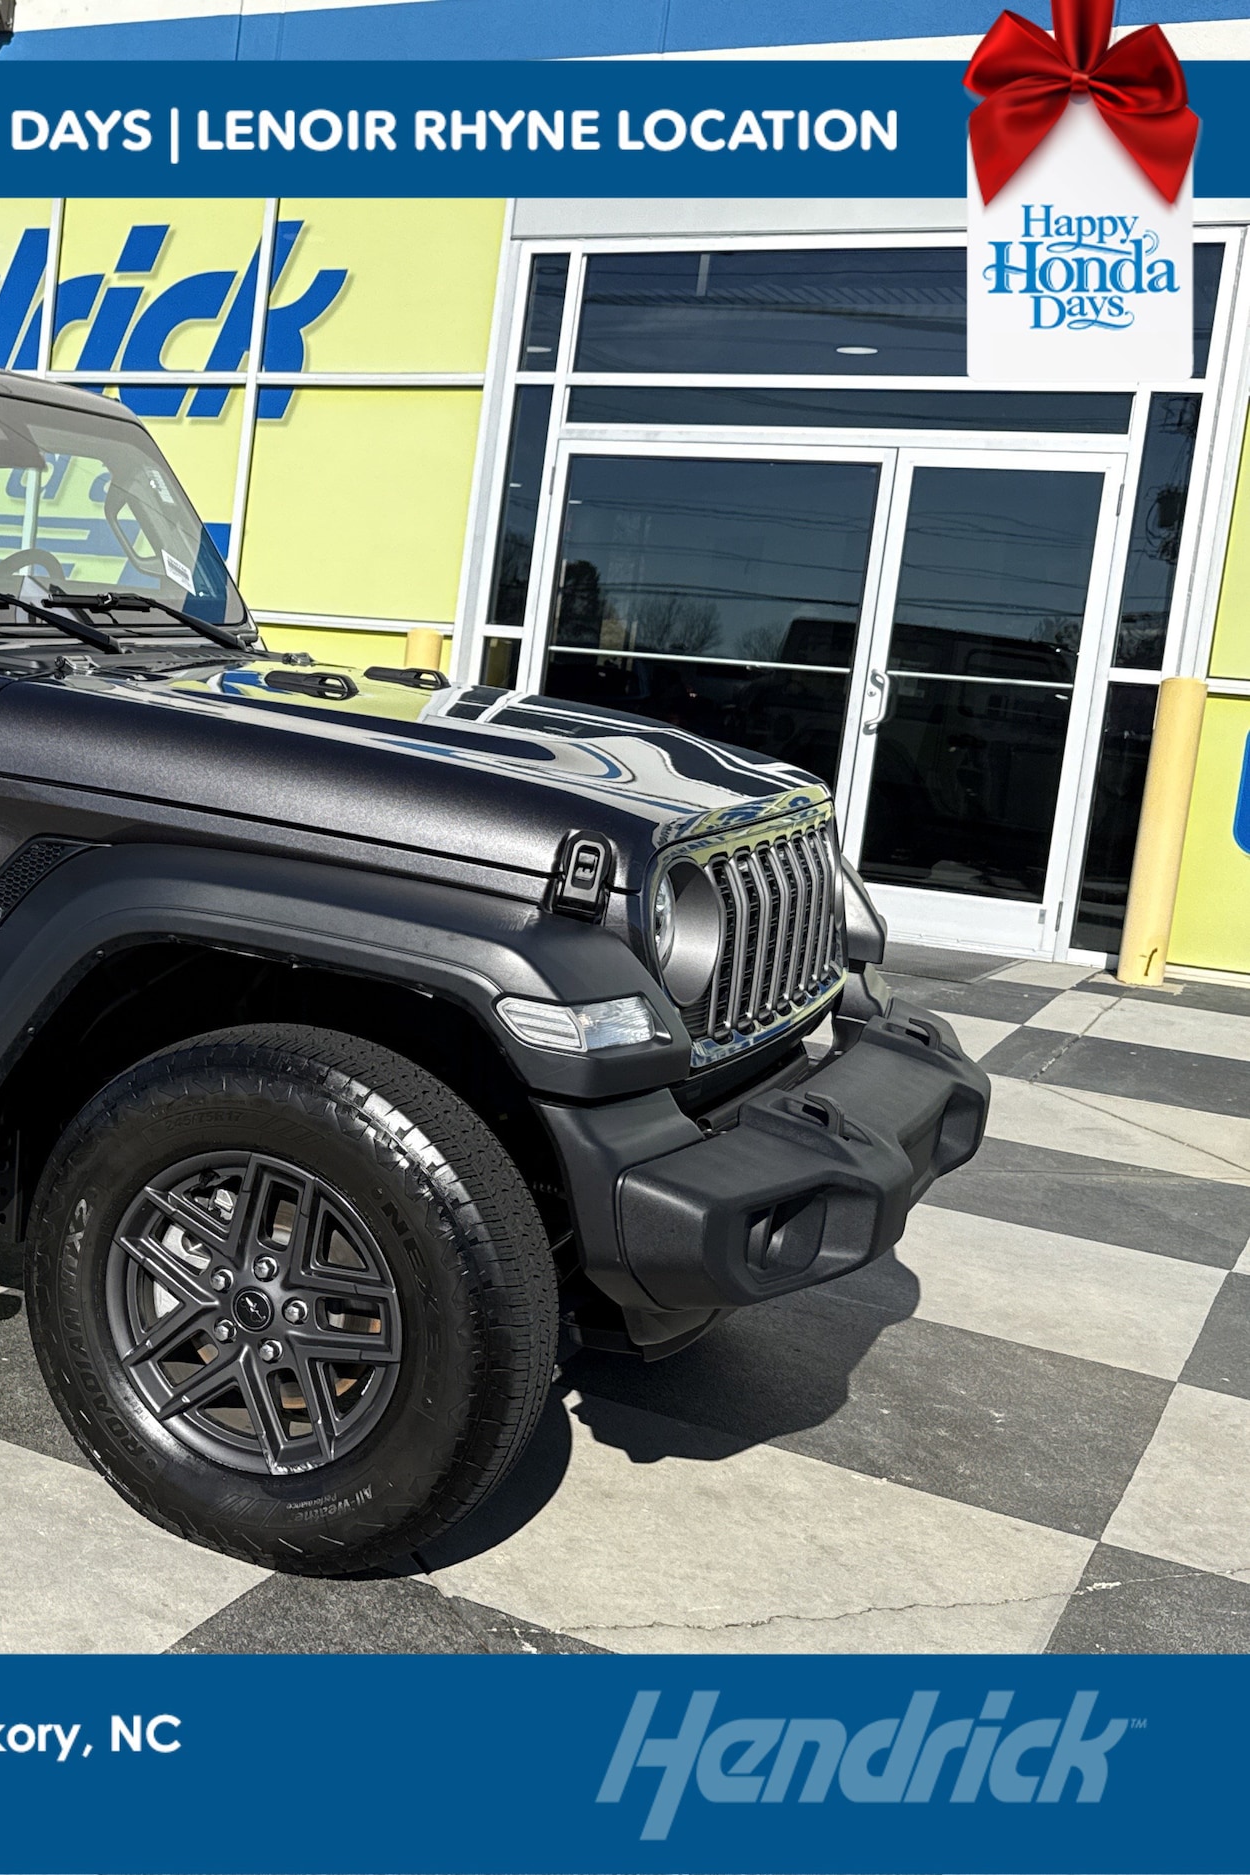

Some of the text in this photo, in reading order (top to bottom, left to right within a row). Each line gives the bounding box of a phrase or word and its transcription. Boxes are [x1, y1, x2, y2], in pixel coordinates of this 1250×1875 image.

[380, 1200, 442, 1391] NEXEN
[61, 1306, 149, 1457] ROADIAN
[293, 1483, 373, 1522] All-Weathe
